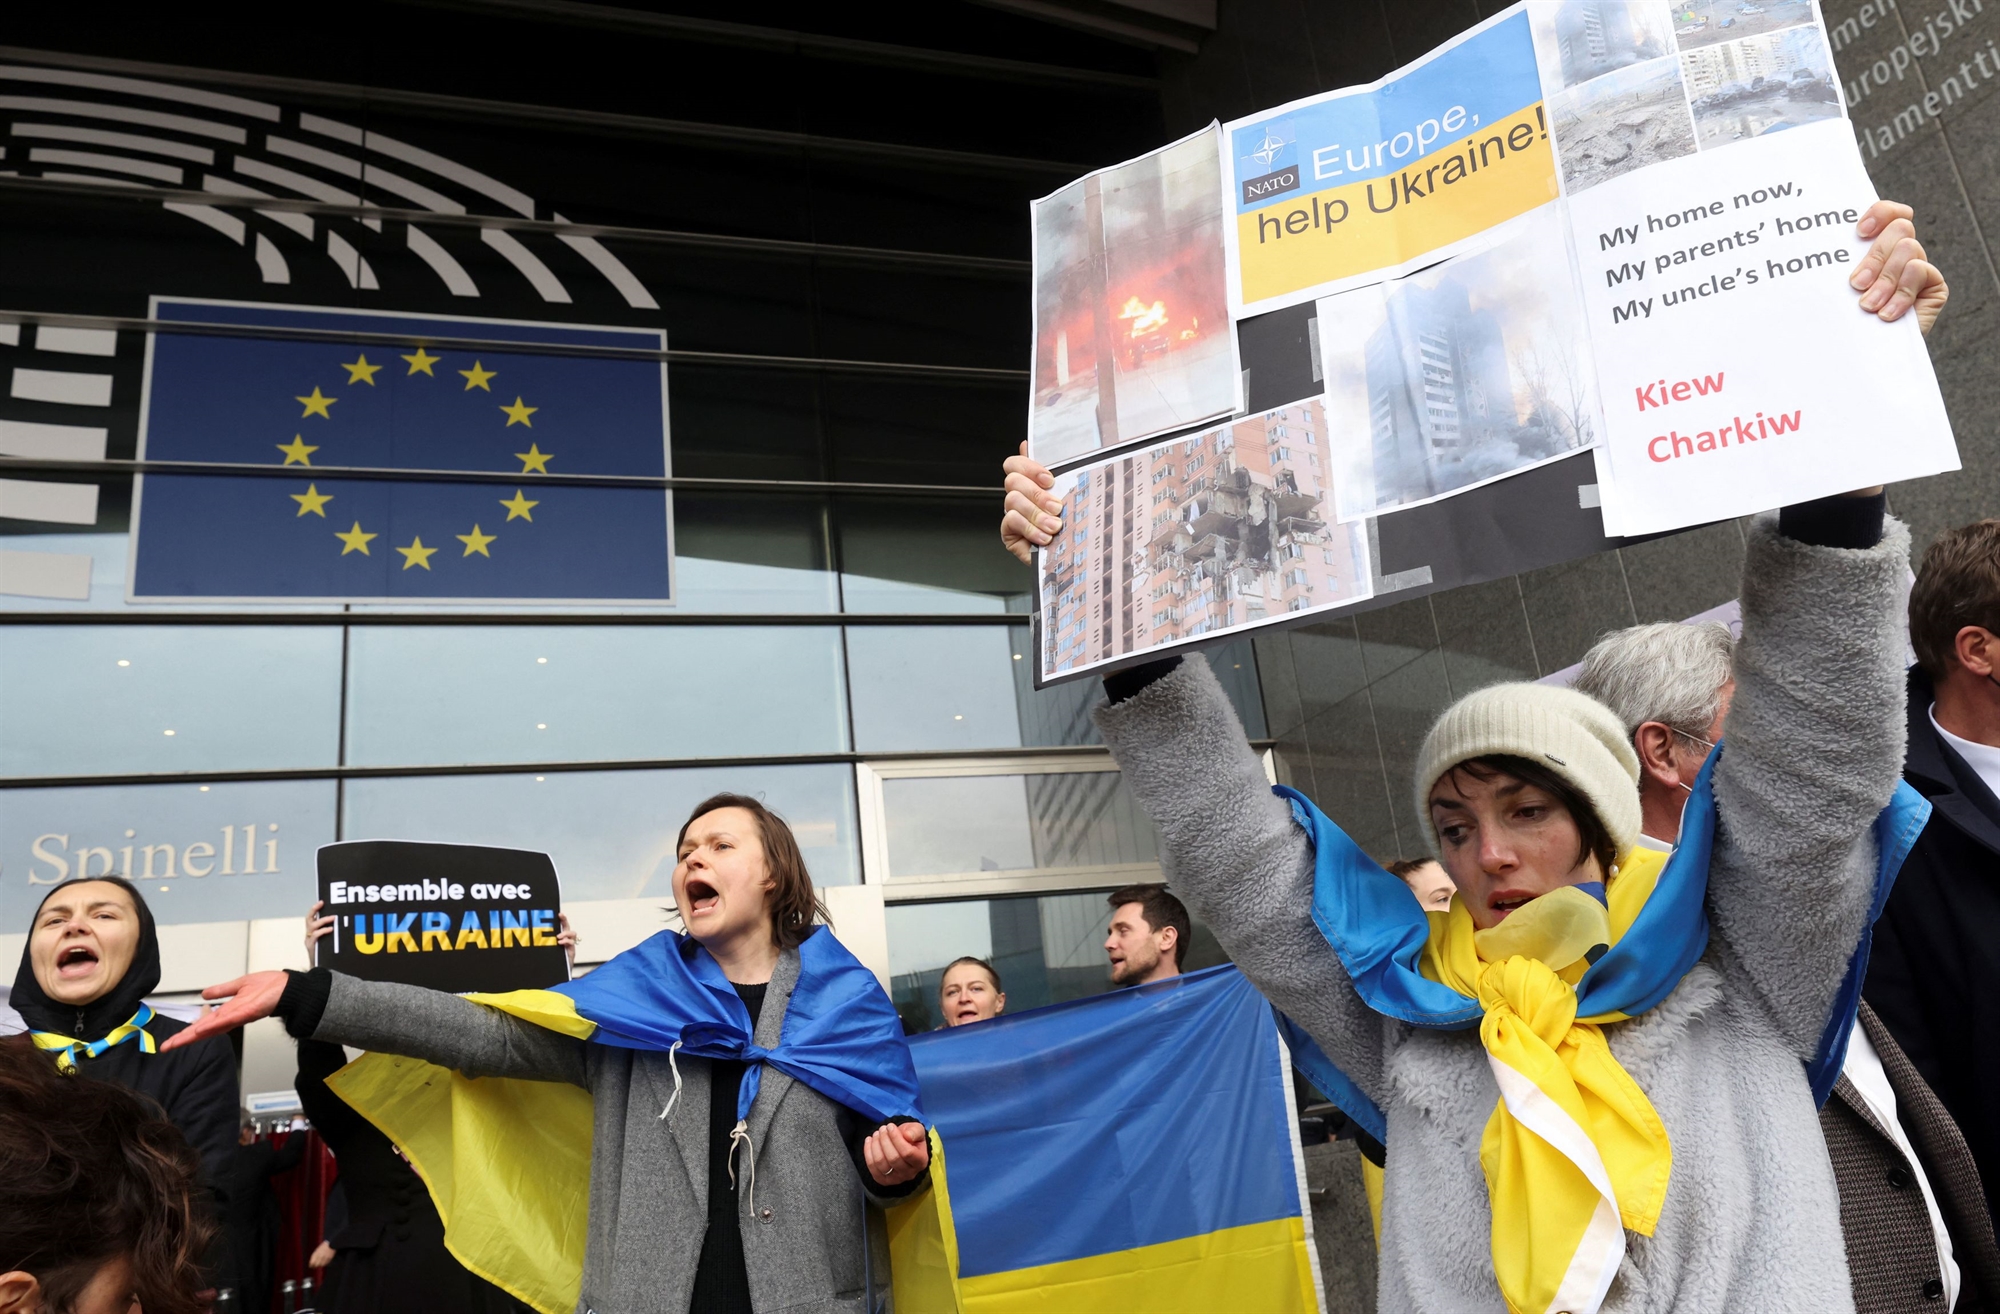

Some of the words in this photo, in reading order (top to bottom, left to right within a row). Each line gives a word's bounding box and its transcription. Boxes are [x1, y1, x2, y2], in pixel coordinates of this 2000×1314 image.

[1258, 197, 1349, 244] help
[1366, 105, 1549, 214] Ukraine!
[1311, 105, 1480, 182] Europe,
[1247, 173, 1295, 198] NATO
[1599, 224, 1639, 252] My
[1646, 200, 1725, 233] home
[1733, 181, 1803, 209] now,
[1605, 260, 1646, 288] My
[1655, 222, 1765, 274] parents’
[1775, 208, 1859, 236] home
[1612, 298, 1653, 324] My
[1662, 267, 1759, 307] uncle’s
[1766, 249, 1850, 279] home
[1635, 372, 1725, 412] Kiew
[1647, 410, 1802, 463] Charkiw
[28, 823, 281, 885] Spinelli
[330, 878, 465, 904] Ensemble
[470, 881, 532, 900] avec
